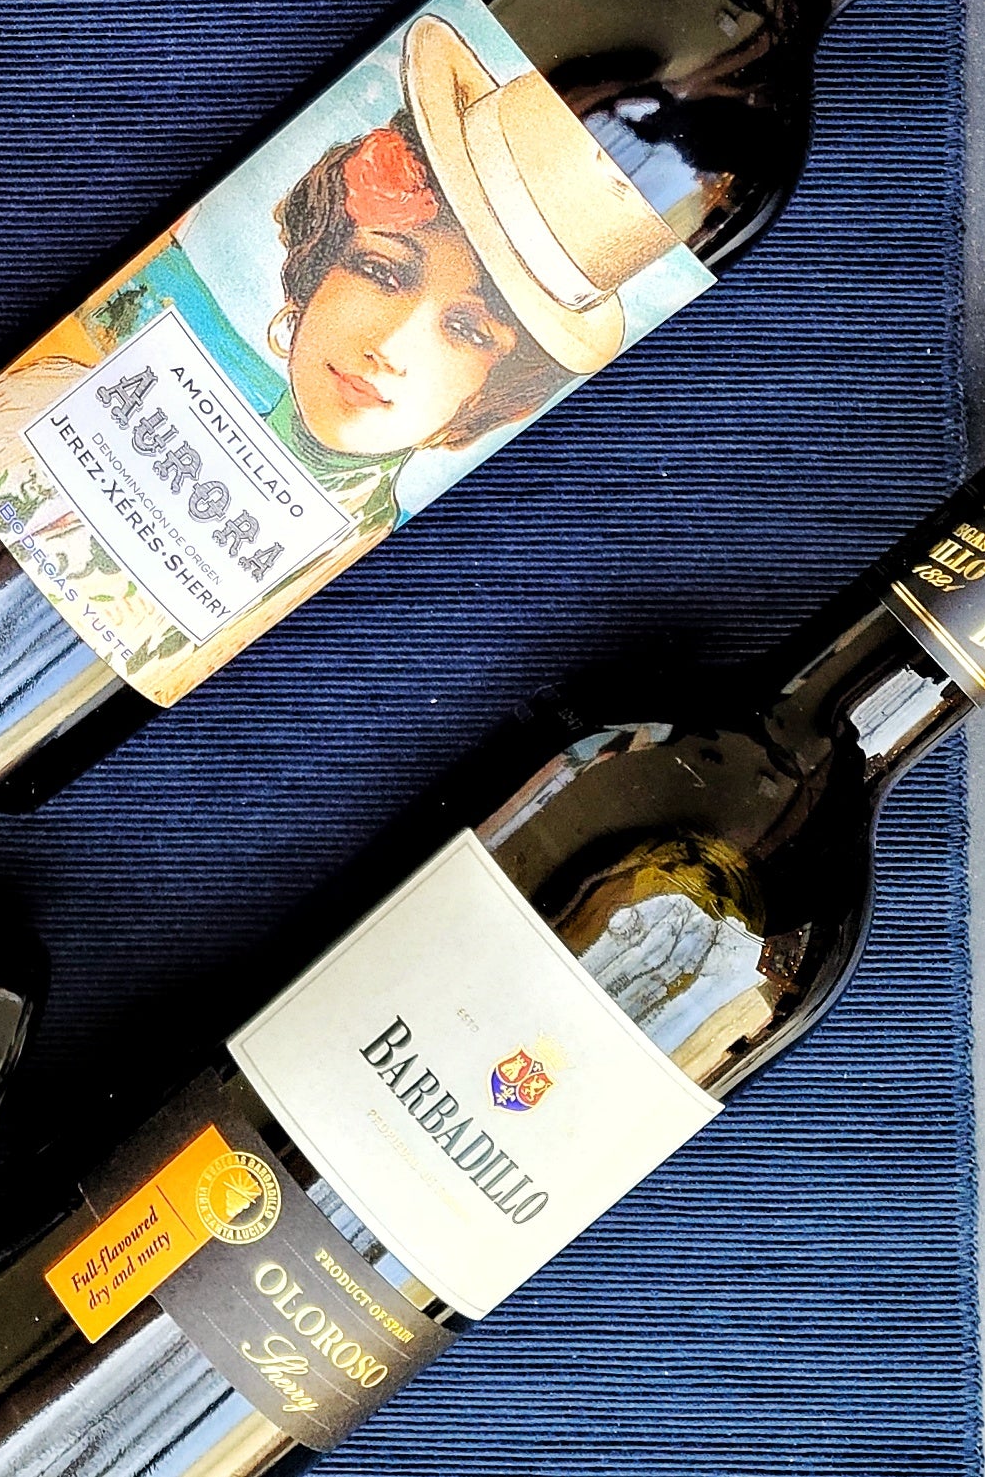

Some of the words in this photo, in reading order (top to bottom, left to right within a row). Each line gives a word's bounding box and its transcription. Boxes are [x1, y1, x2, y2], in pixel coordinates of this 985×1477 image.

[95, 365, 285, 583] AURORA
[170, 366, 305, 519] AMONTILLADO
[91, 432, 171, 530] DENOMINACIÓN
[168, 523, 186, 547] DE
[184, 544, 224, 586] ORIGEN
[929, 538, 985, 581] ILLO
[0, 503, 79, 602] BODEGAS
[82, 603, 134, 662] YUSTE
[911, 564, 966, 592] 1821
[359, 1015, 550, 1225] BARBADILLO
[71, 1205, 159, 1293] Full-flavoured
[88, 1284, 111, 1310] dry
[112, 1256, 136, 1290] and
[137, 1231, 172, 1260] nutty
[315, 1247, 373, 1308] PRODUCT
[368, 1303, 386, 1322] OF
[382, 1317, 416, 1344] SPAIN
[241, 1335, 319, 1413] Sherry
[255, 1263, 389, 1389] OLOROSO
